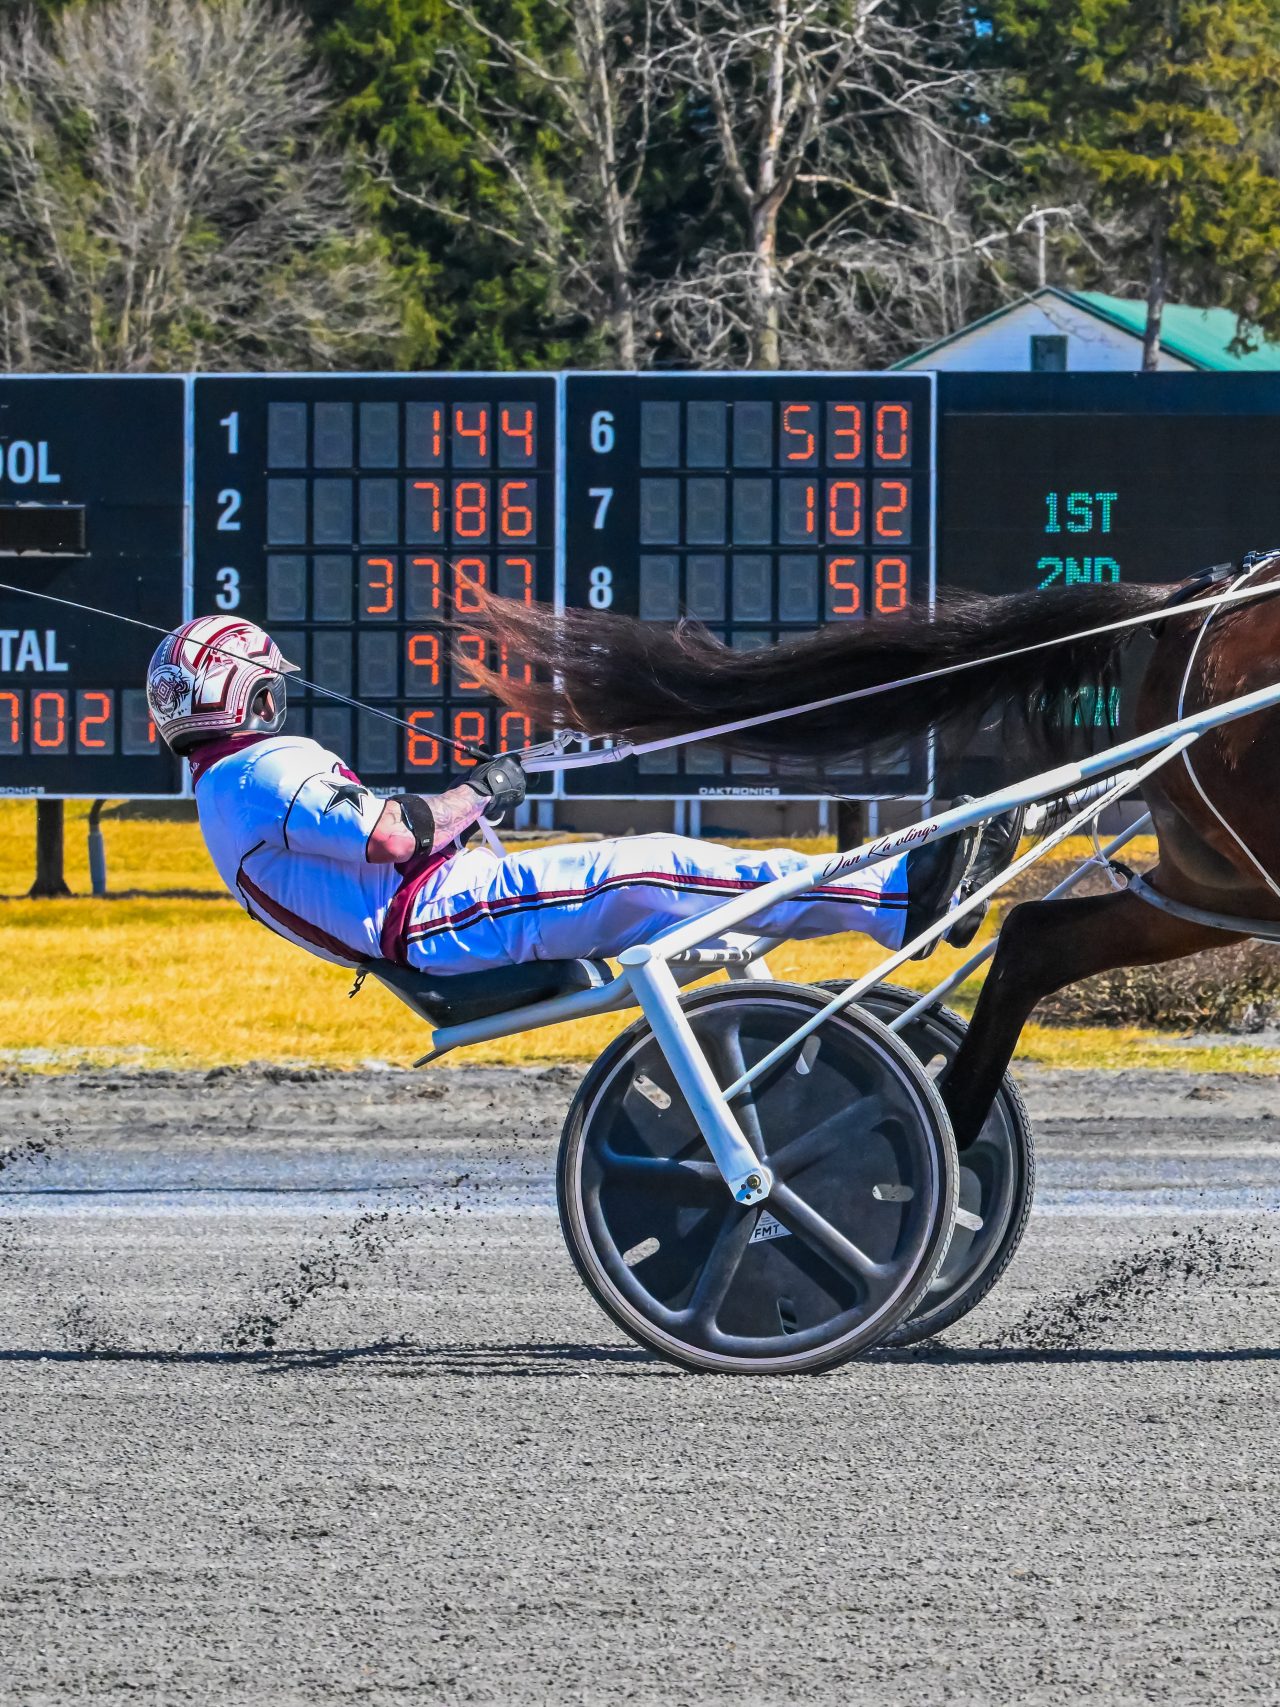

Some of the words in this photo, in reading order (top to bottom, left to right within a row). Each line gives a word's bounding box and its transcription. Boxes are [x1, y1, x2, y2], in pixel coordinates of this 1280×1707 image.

[219, 411, 239, 454] 1
[433, 410, 532, 457] 144
[590, 410, 615, 454] 6
[784, 405, 908, 459] 530
[0, 440, 61, 484] OL
[216, 488, 241, 531] 2
[413, 482, 532, 537] 786
[588, 487, 614, 530] 7
[806, 481, 908, 536] 102
[1045, 492, 1119, 534] 1ST
[215, 567, 241, 610] 3
[366, 558, 532, 614] 3787
[589, 566, 613, 609] 8
[828, 558, 907, 613] 58
[754, 1224, 780, 1238] FMT
